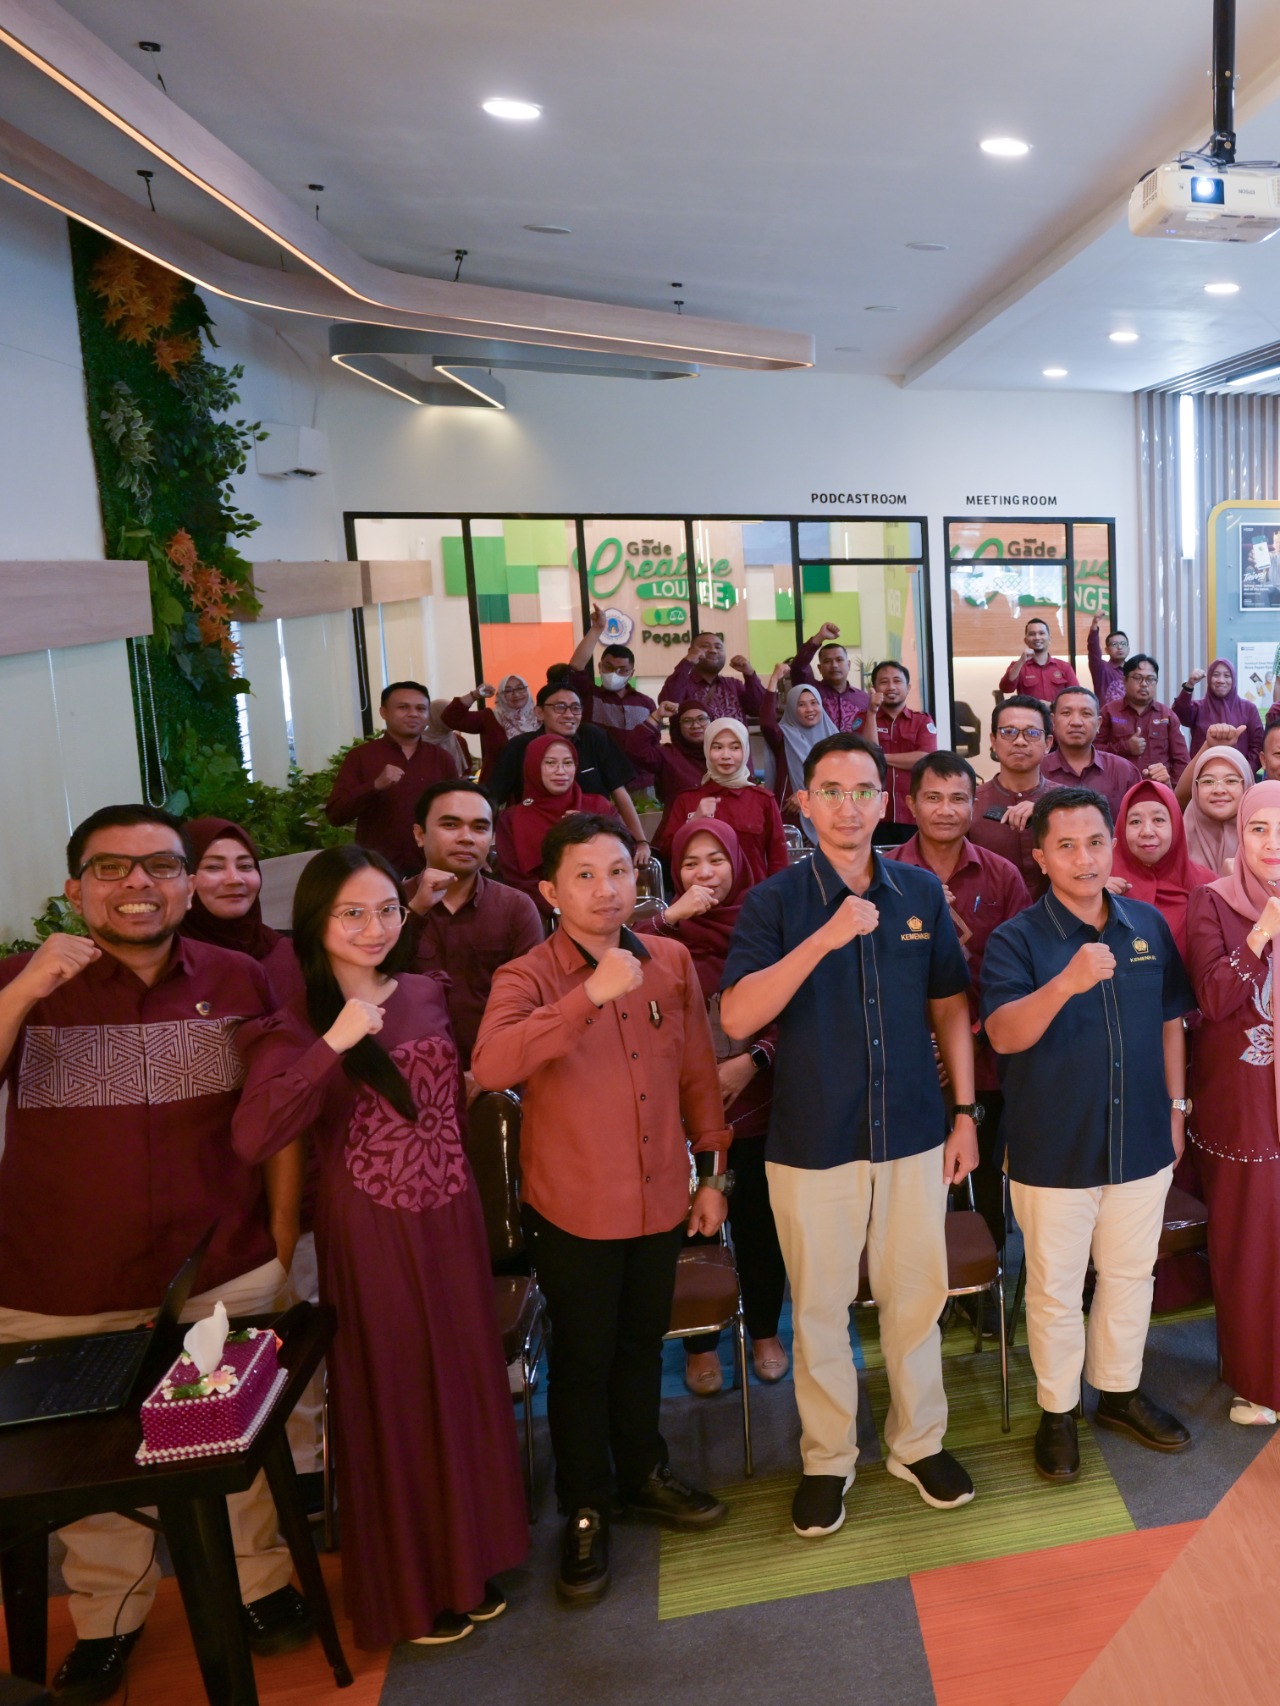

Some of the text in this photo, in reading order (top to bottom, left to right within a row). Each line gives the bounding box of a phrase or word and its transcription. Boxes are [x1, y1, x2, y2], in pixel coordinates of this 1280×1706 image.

[966, 495, 1058, 506] MEETING ROOM
[626, 541, 672, 556] Gade
[1007, 541, 1057, 557] Gade
